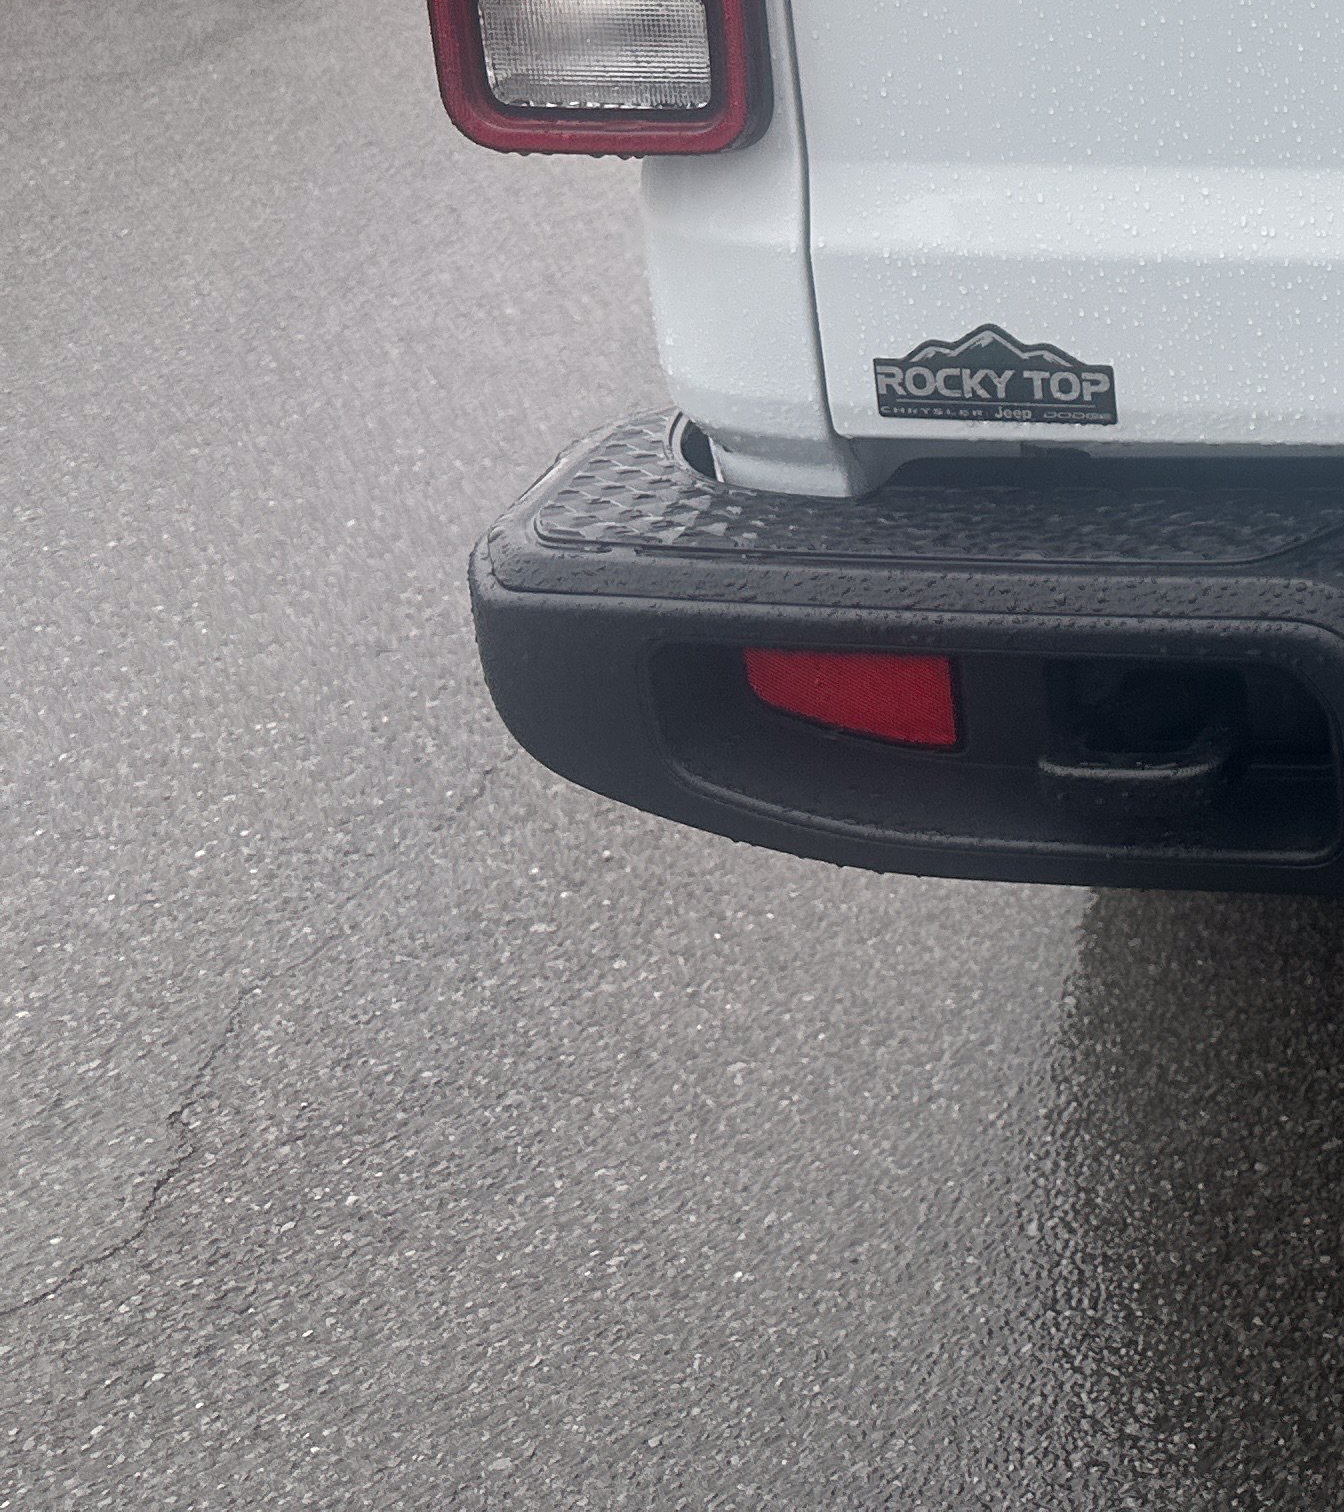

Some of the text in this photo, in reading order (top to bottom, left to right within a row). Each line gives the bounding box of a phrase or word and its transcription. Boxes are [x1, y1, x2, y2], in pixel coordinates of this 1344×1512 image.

[876, 365, 1111, 402] ROCKY TOP
[995, 407, 1032, 419] Jeep
